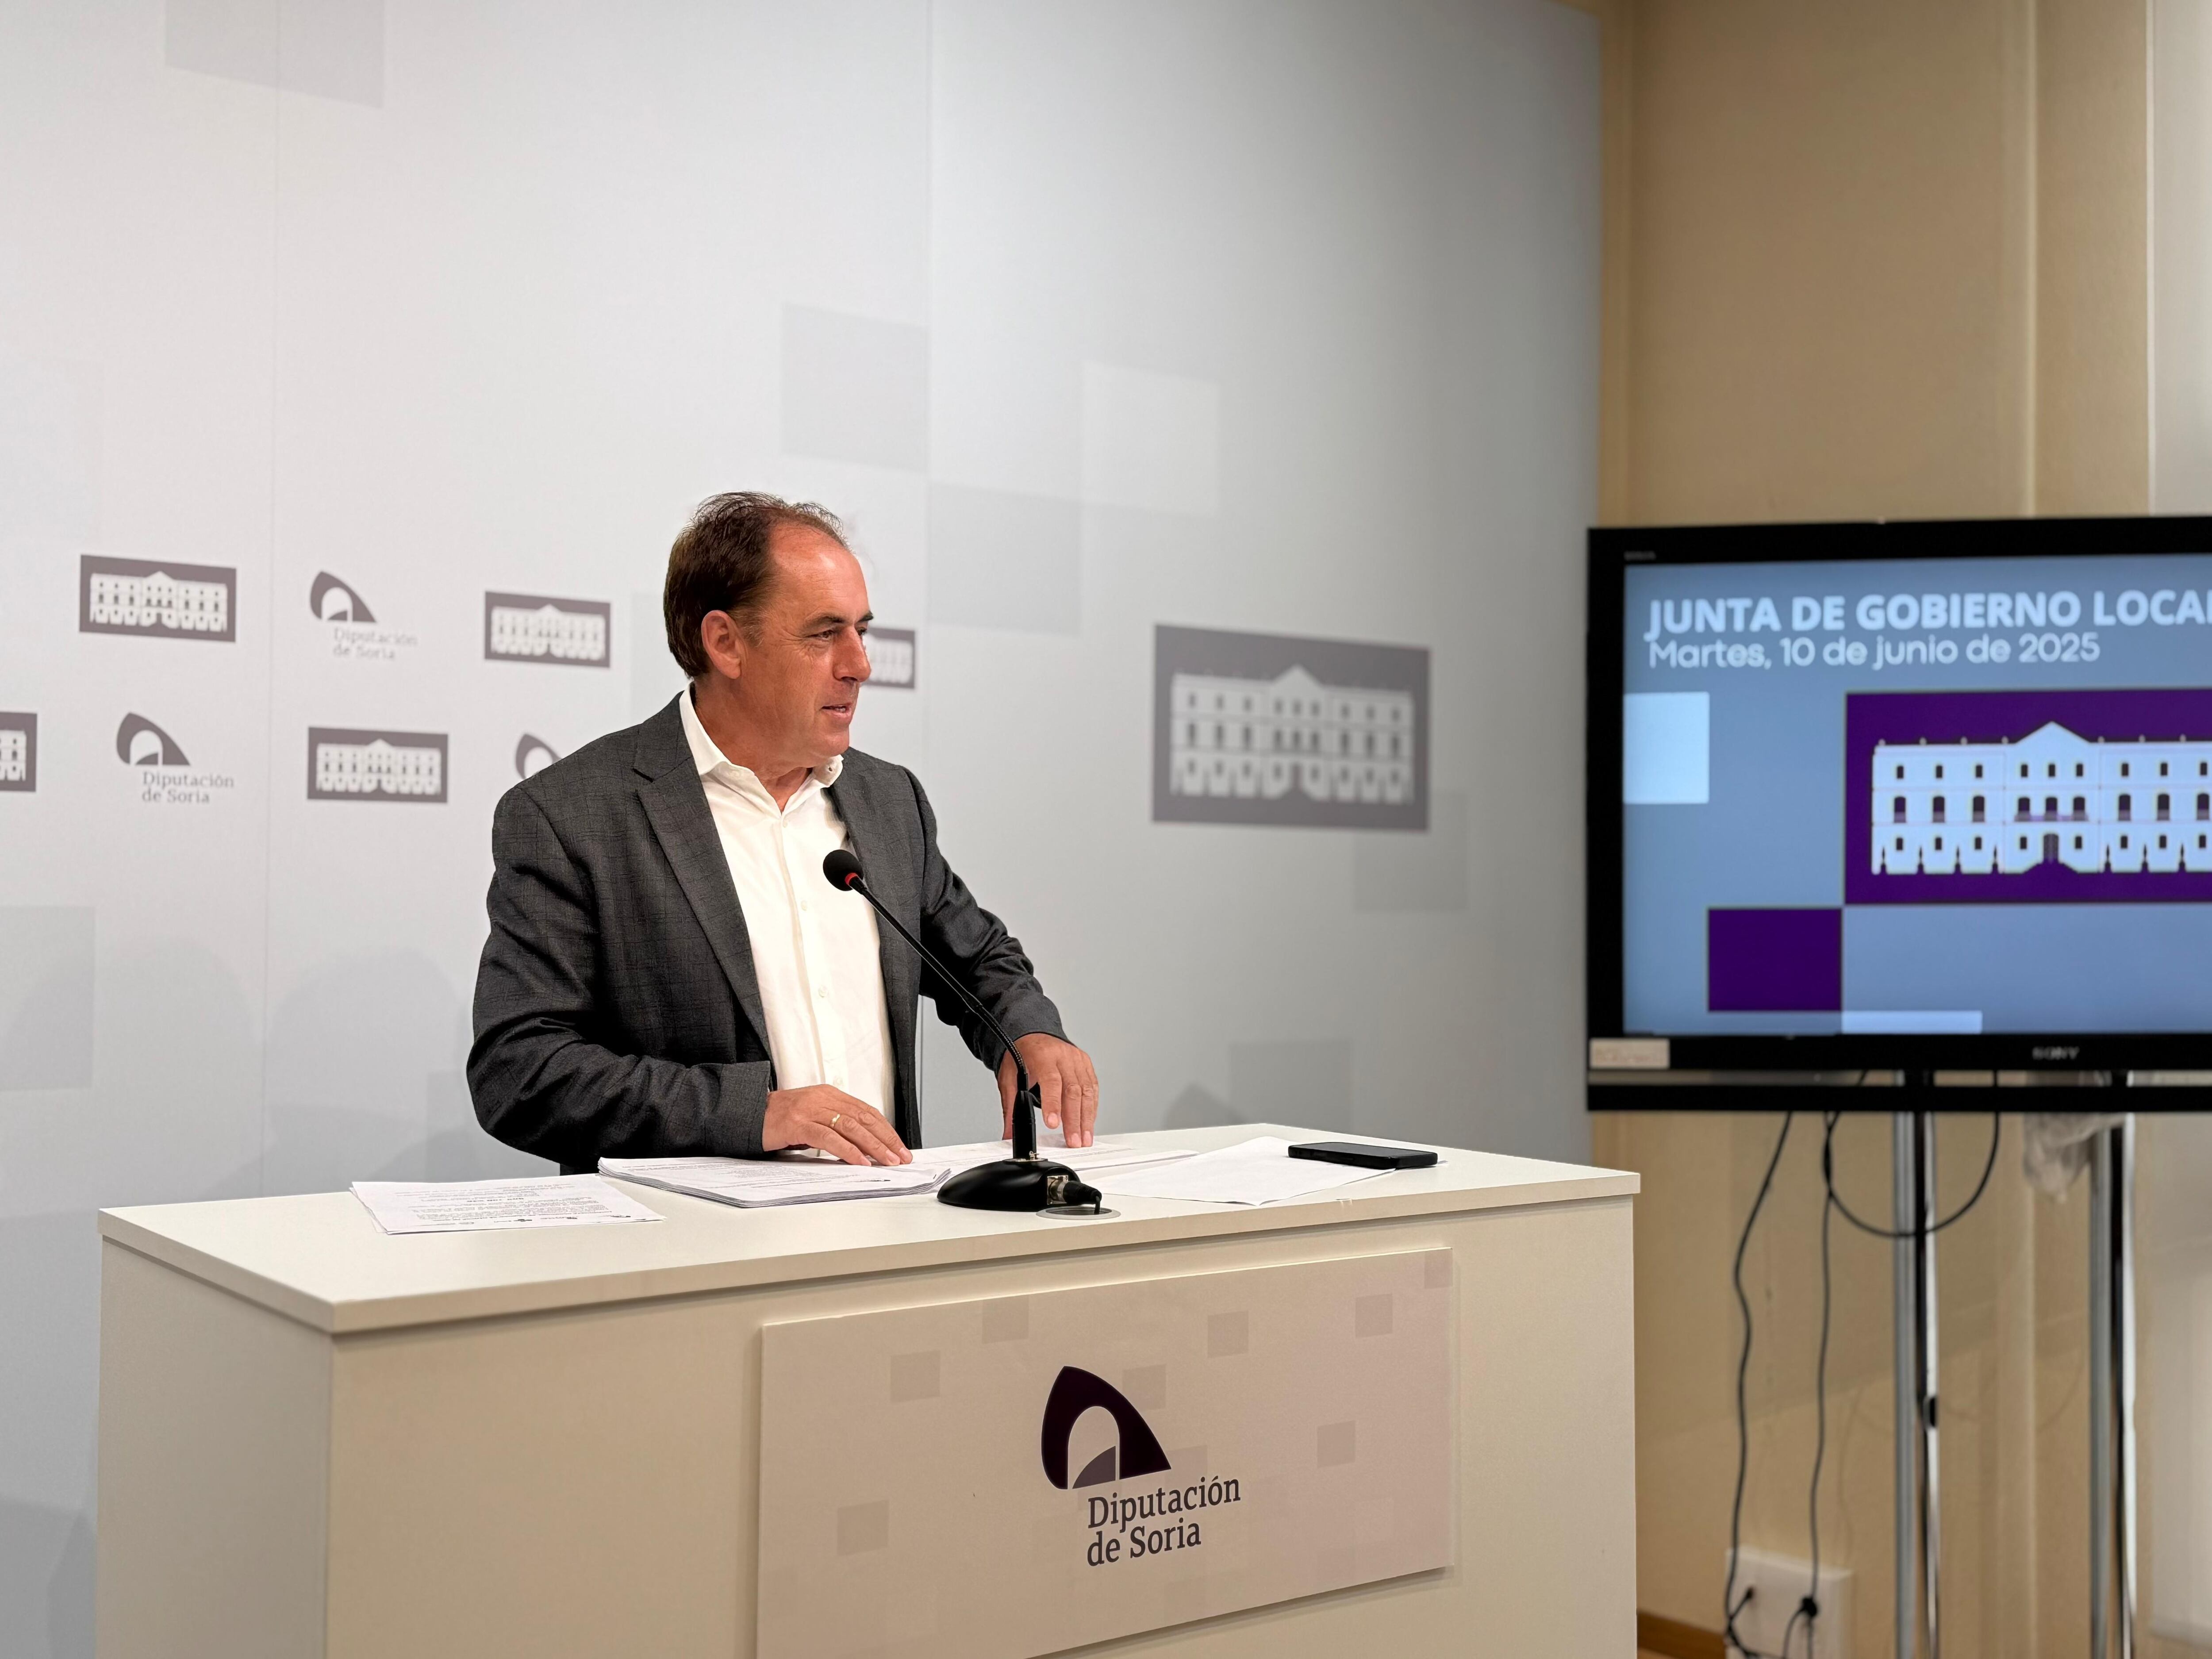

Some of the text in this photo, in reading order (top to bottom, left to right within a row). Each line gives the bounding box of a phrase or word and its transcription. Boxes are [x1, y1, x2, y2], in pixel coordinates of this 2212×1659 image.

[1644, 589, 2212, 642] JUNTA DE GOBIERNO LOCA
[1649, 631, 2101, 675] Martes, 10 de junio de 2025
[142, 771, 234, 789] Diputación
[142, 786, 210, 803] de Soria
[1087, 1475, 1241, 1533] Diputación
[1087, 1517, 1202, 1567] de Soria
